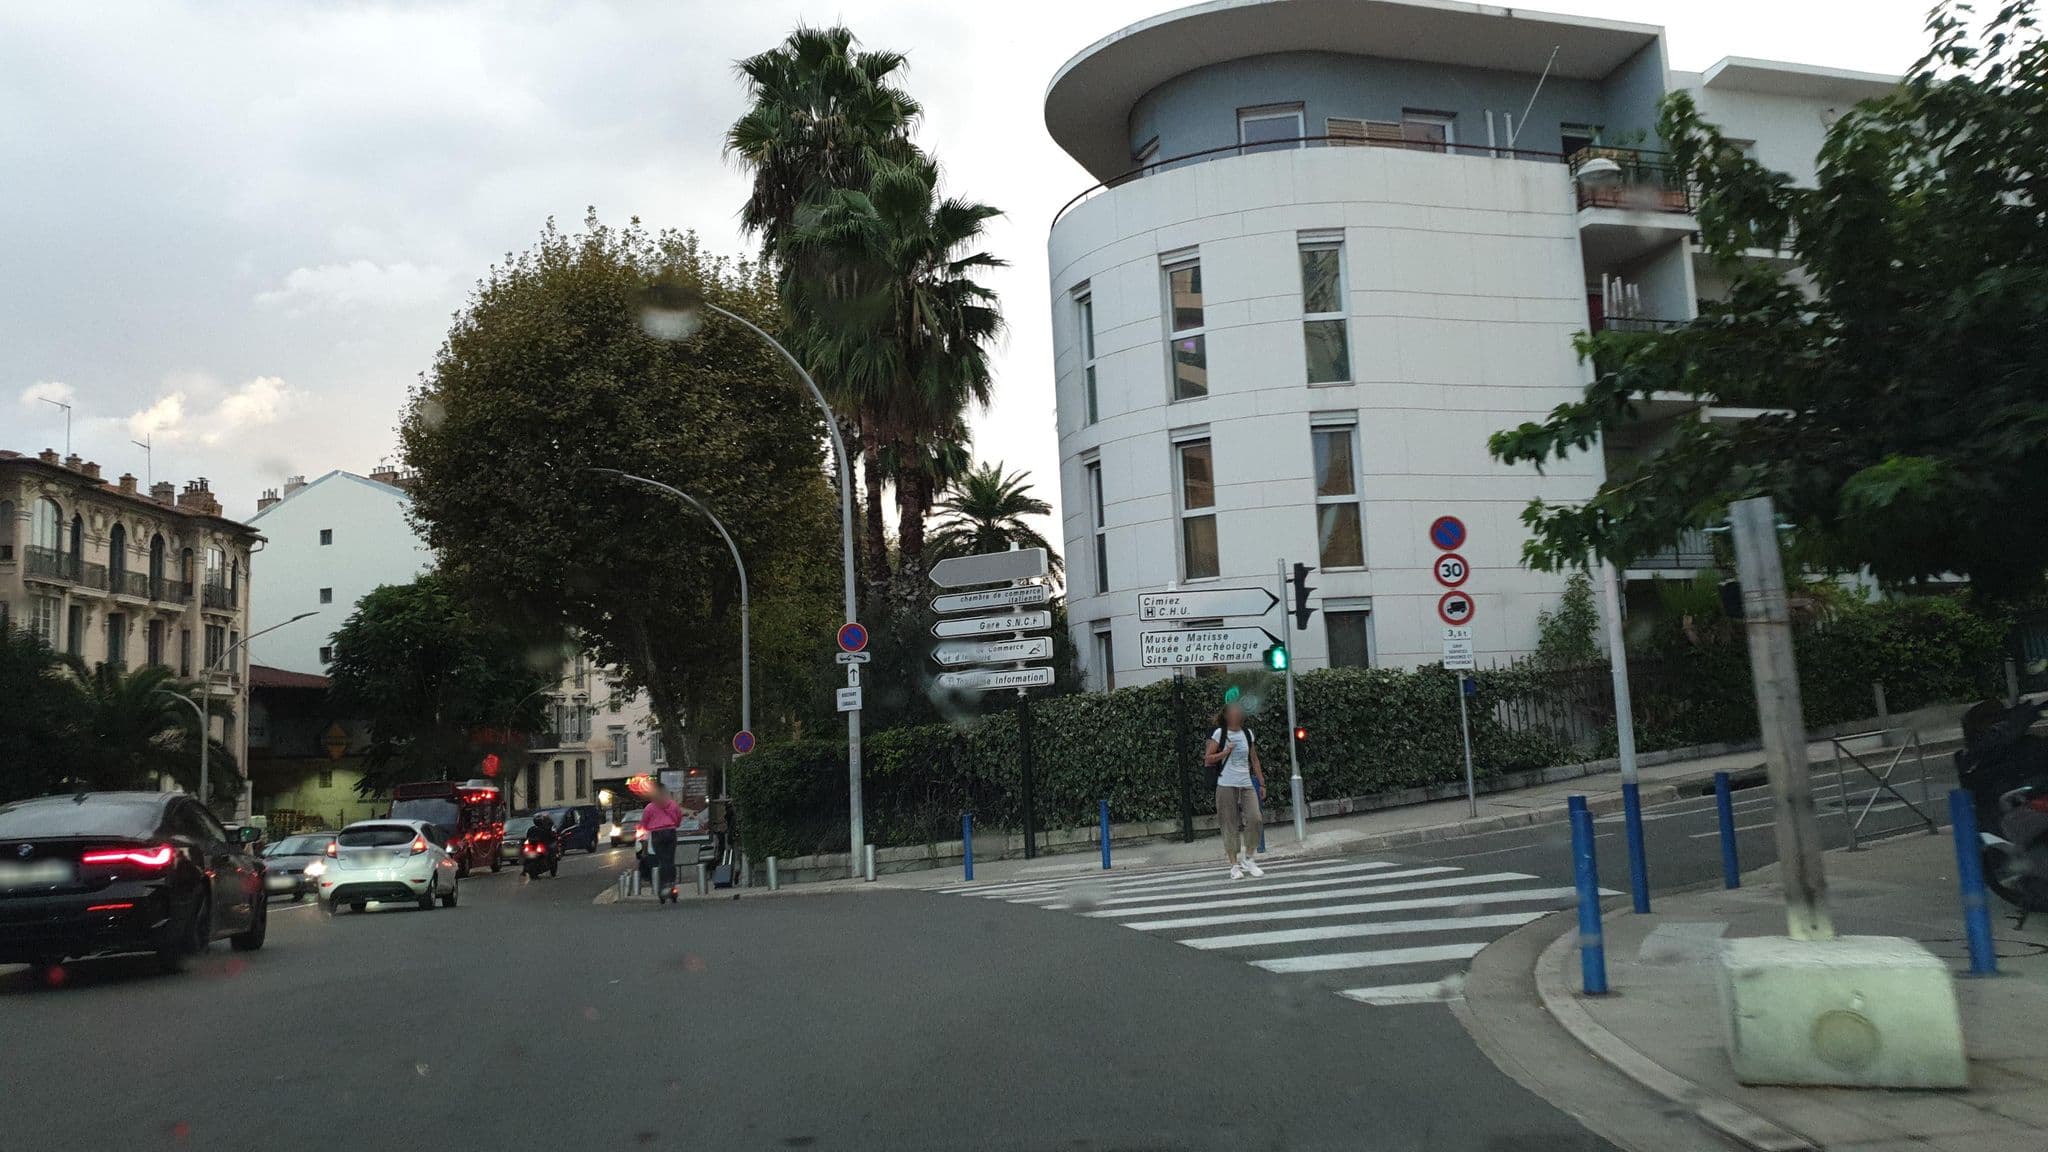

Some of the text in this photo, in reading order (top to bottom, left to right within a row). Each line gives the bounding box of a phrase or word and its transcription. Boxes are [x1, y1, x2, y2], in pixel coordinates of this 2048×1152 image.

[1442, 562, 1462, 578] 30
[1143, 597, 1181, 606] Cimiez
[1144, 632, 1229, 644] Musée Matisse
[1145, 642, 1258, 654] Musée d'Archéologie
[1146, 652, 1252, 664] Site Gallo Romain
[995, 672, 1044, 684] Information
